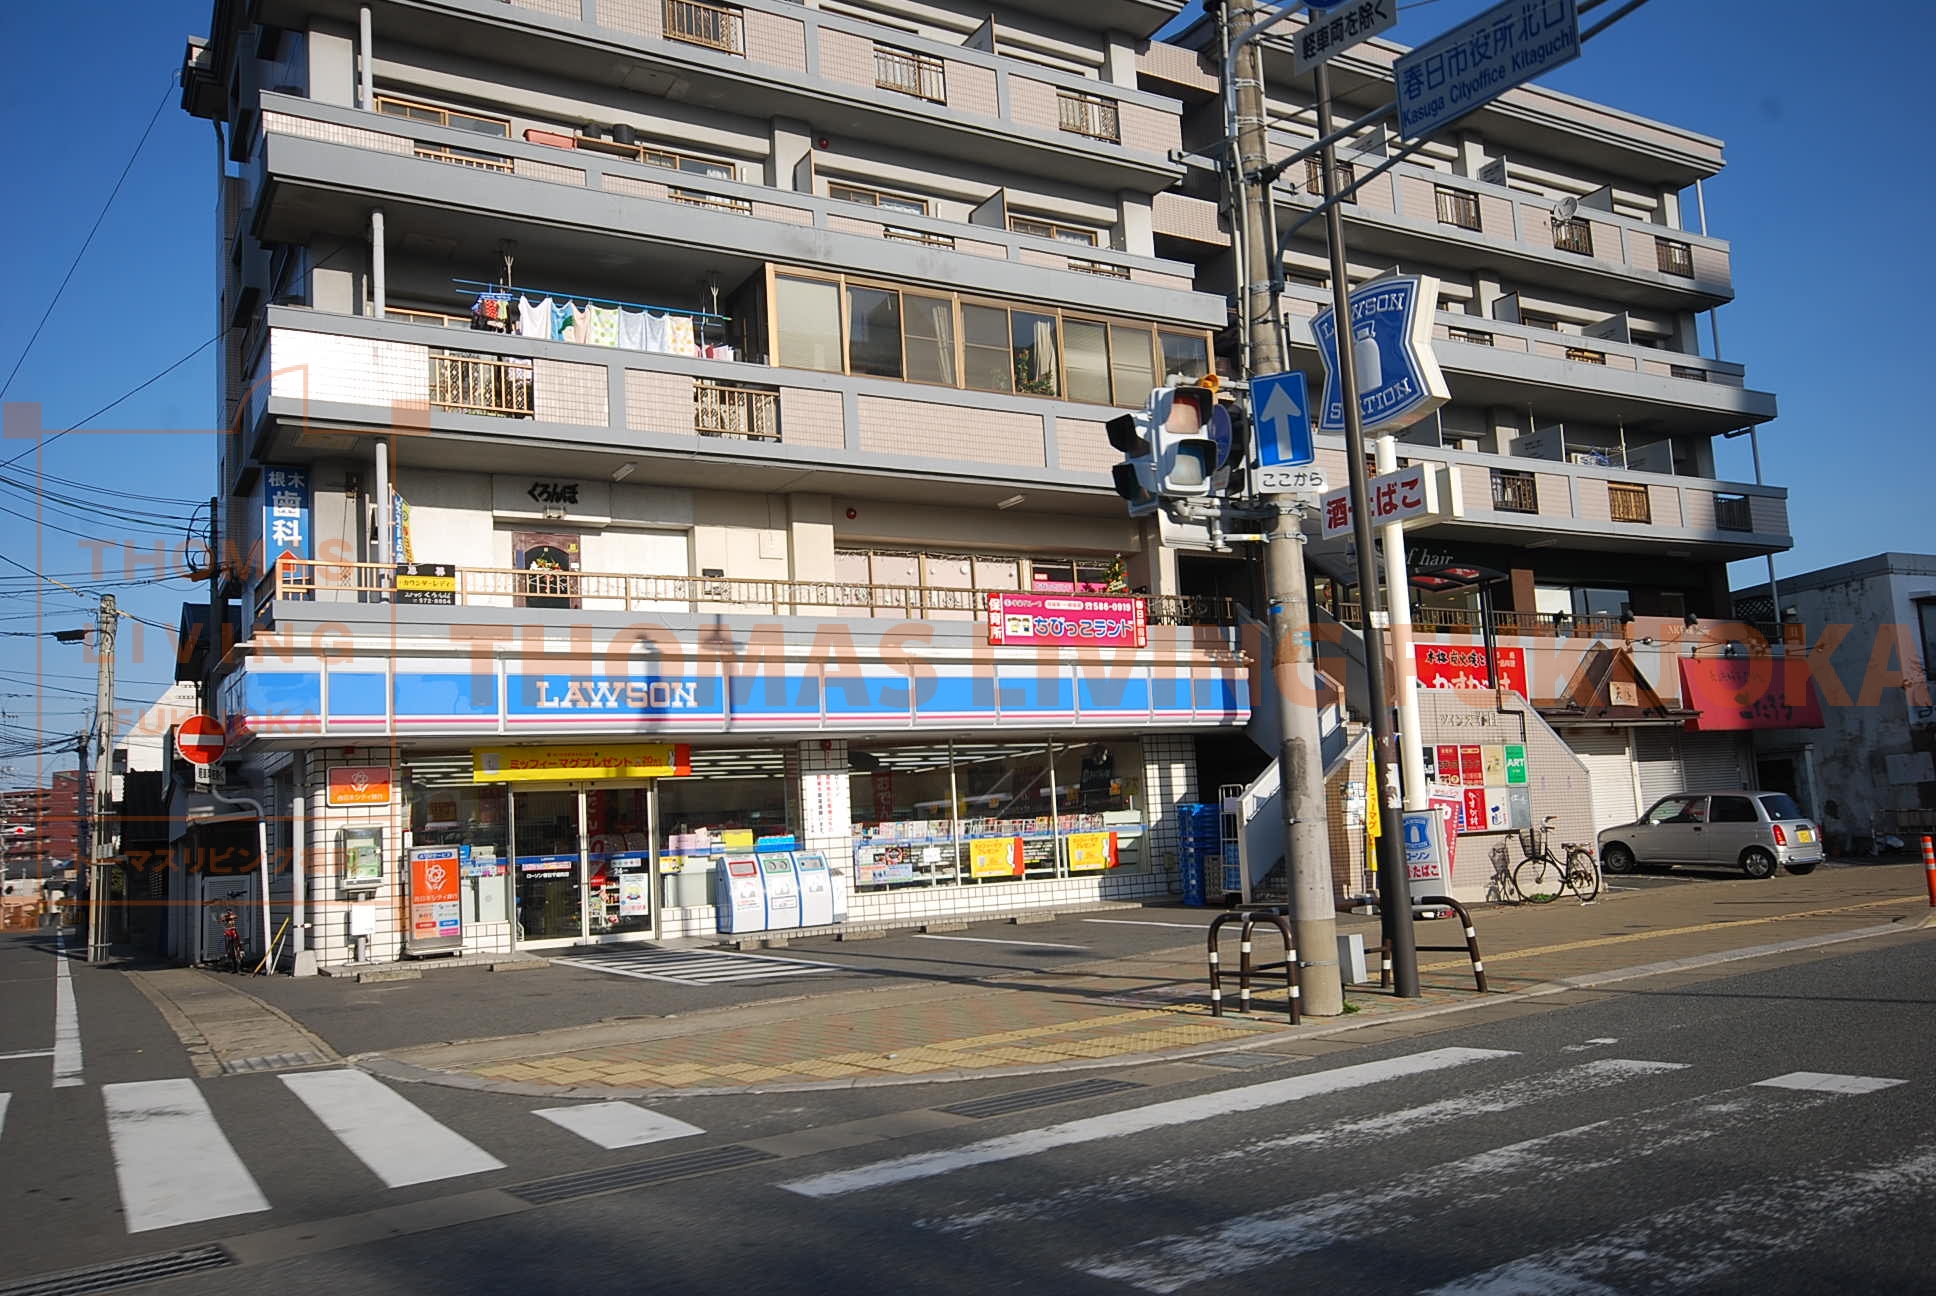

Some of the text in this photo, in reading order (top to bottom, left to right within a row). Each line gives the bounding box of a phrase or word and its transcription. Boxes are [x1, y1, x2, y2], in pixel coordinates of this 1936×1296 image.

[1403, 0, 1566, 100] 春日市役所北口
[1403, 25, 1574, 129] Kasuga Cityoffice Kitaguchi
[268, 472, 304, 488] 根木
[1262, 472, 1323, 487] ここから
[272, 491, 302, 547] 歯科
[1420, 549, 1454, 565] hair
[989, 598, 1001, 639] 保育所
[1034, 617, 1134, 638] ちびっこランド
[536, 681, 698, 708] LAWSON
[1507, 758, 1525, 767] ART
